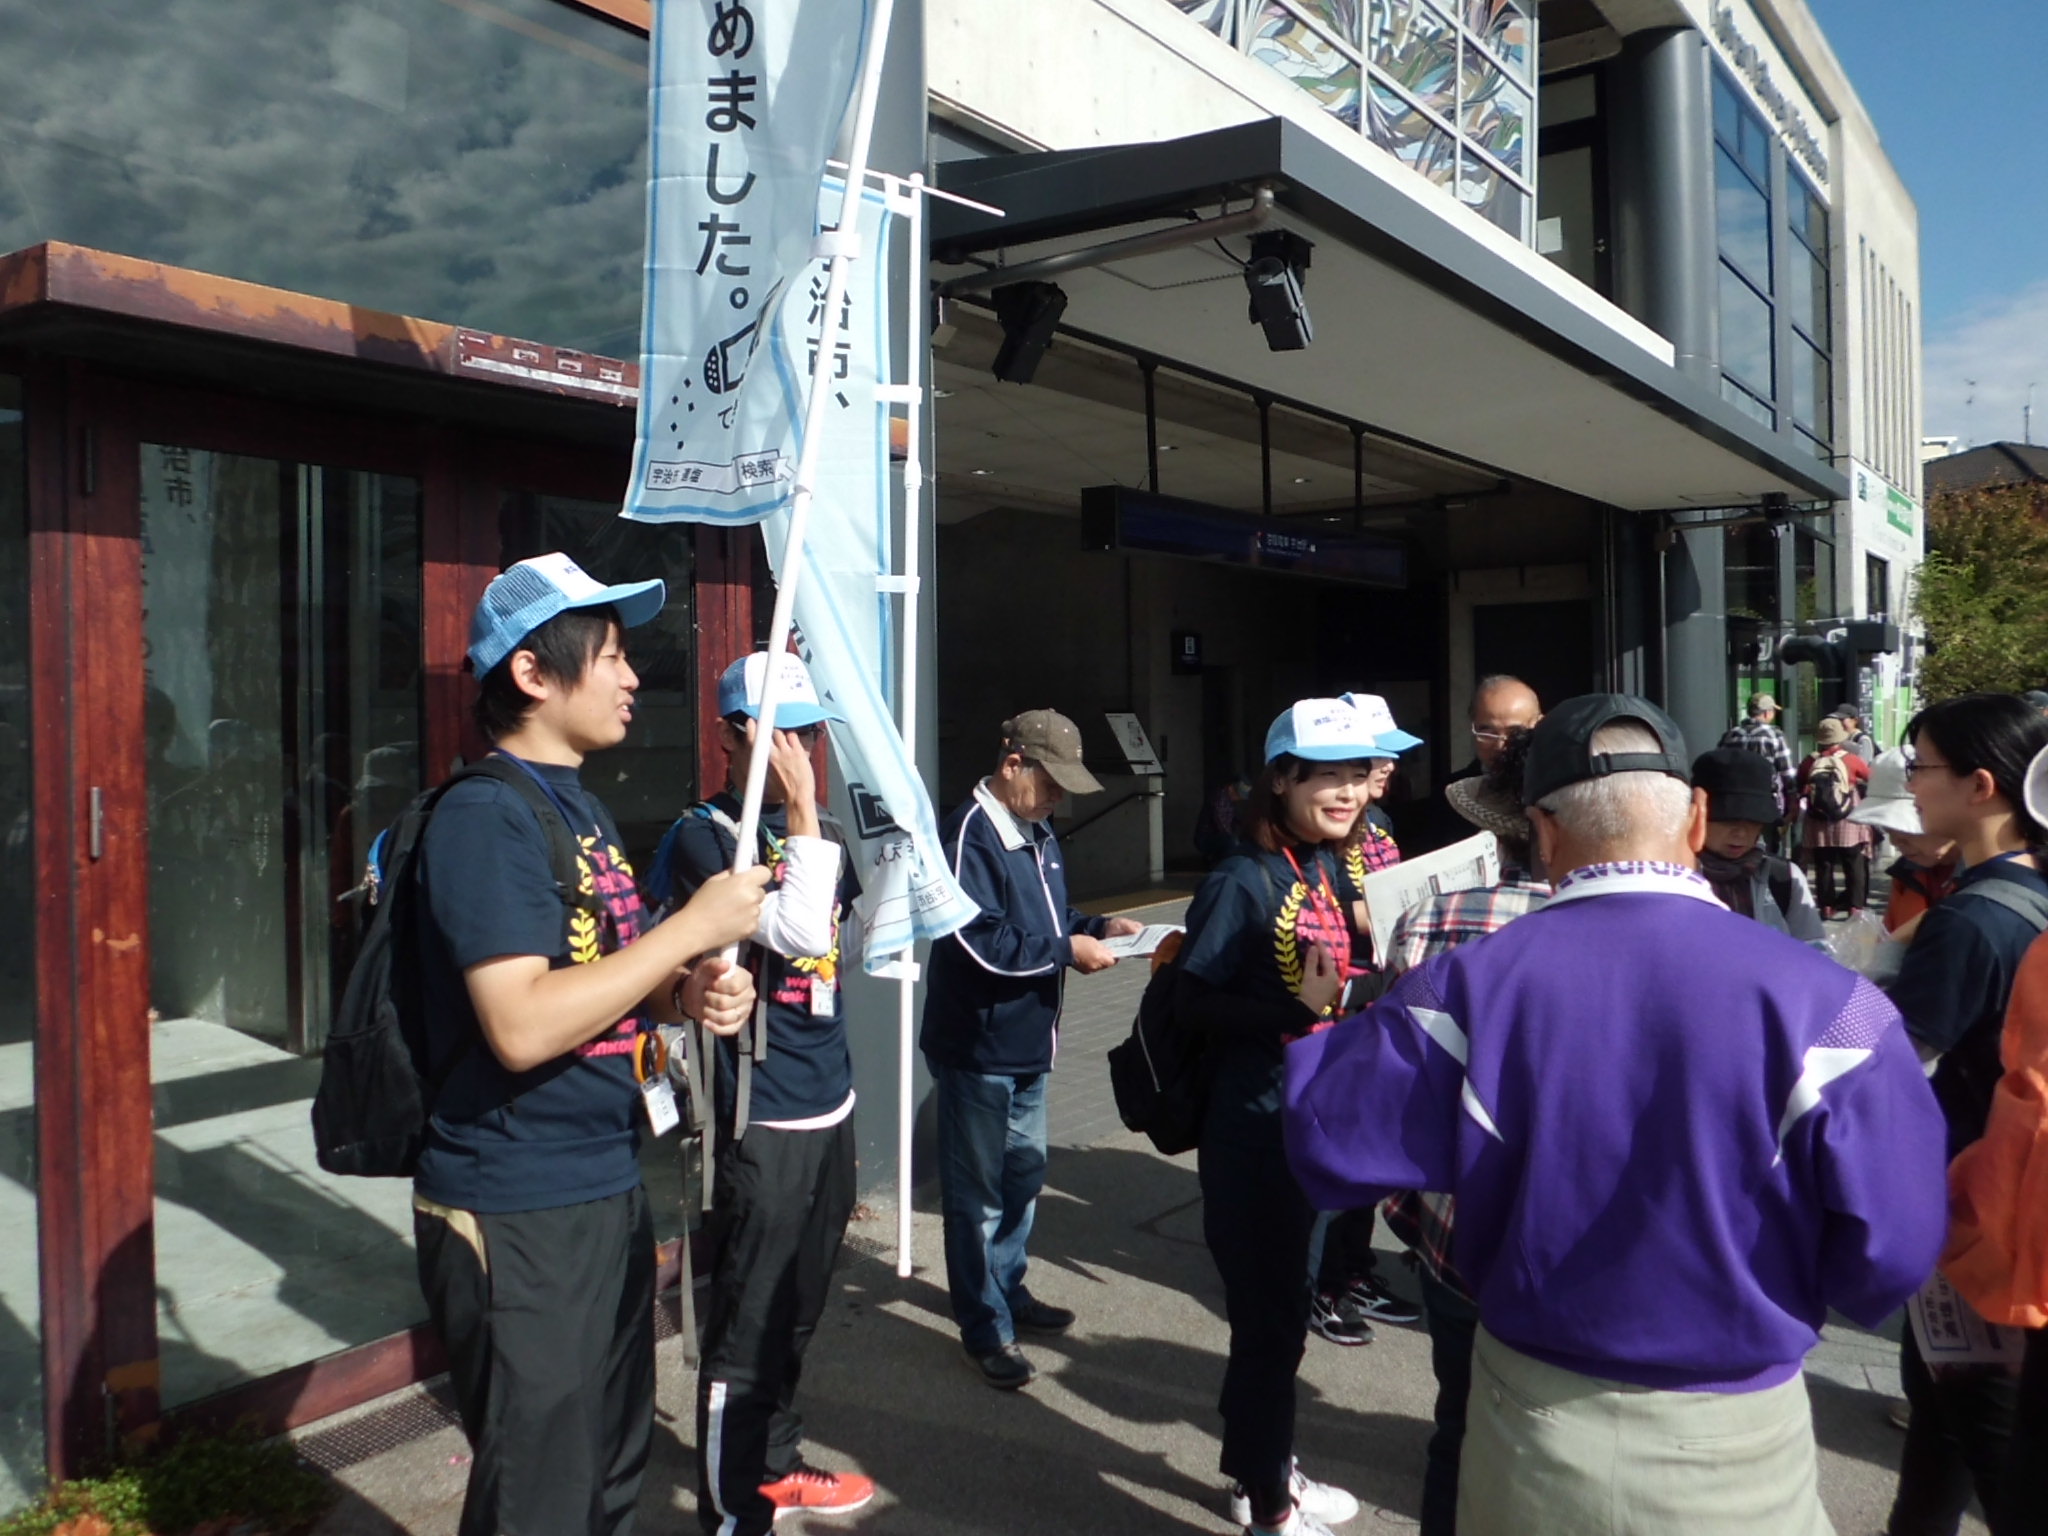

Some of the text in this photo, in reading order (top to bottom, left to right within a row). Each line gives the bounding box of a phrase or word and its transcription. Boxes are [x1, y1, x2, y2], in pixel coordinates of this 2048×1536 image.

[695, 0, 758, 310] めました。
[740, 458, 774, 480] 検索
